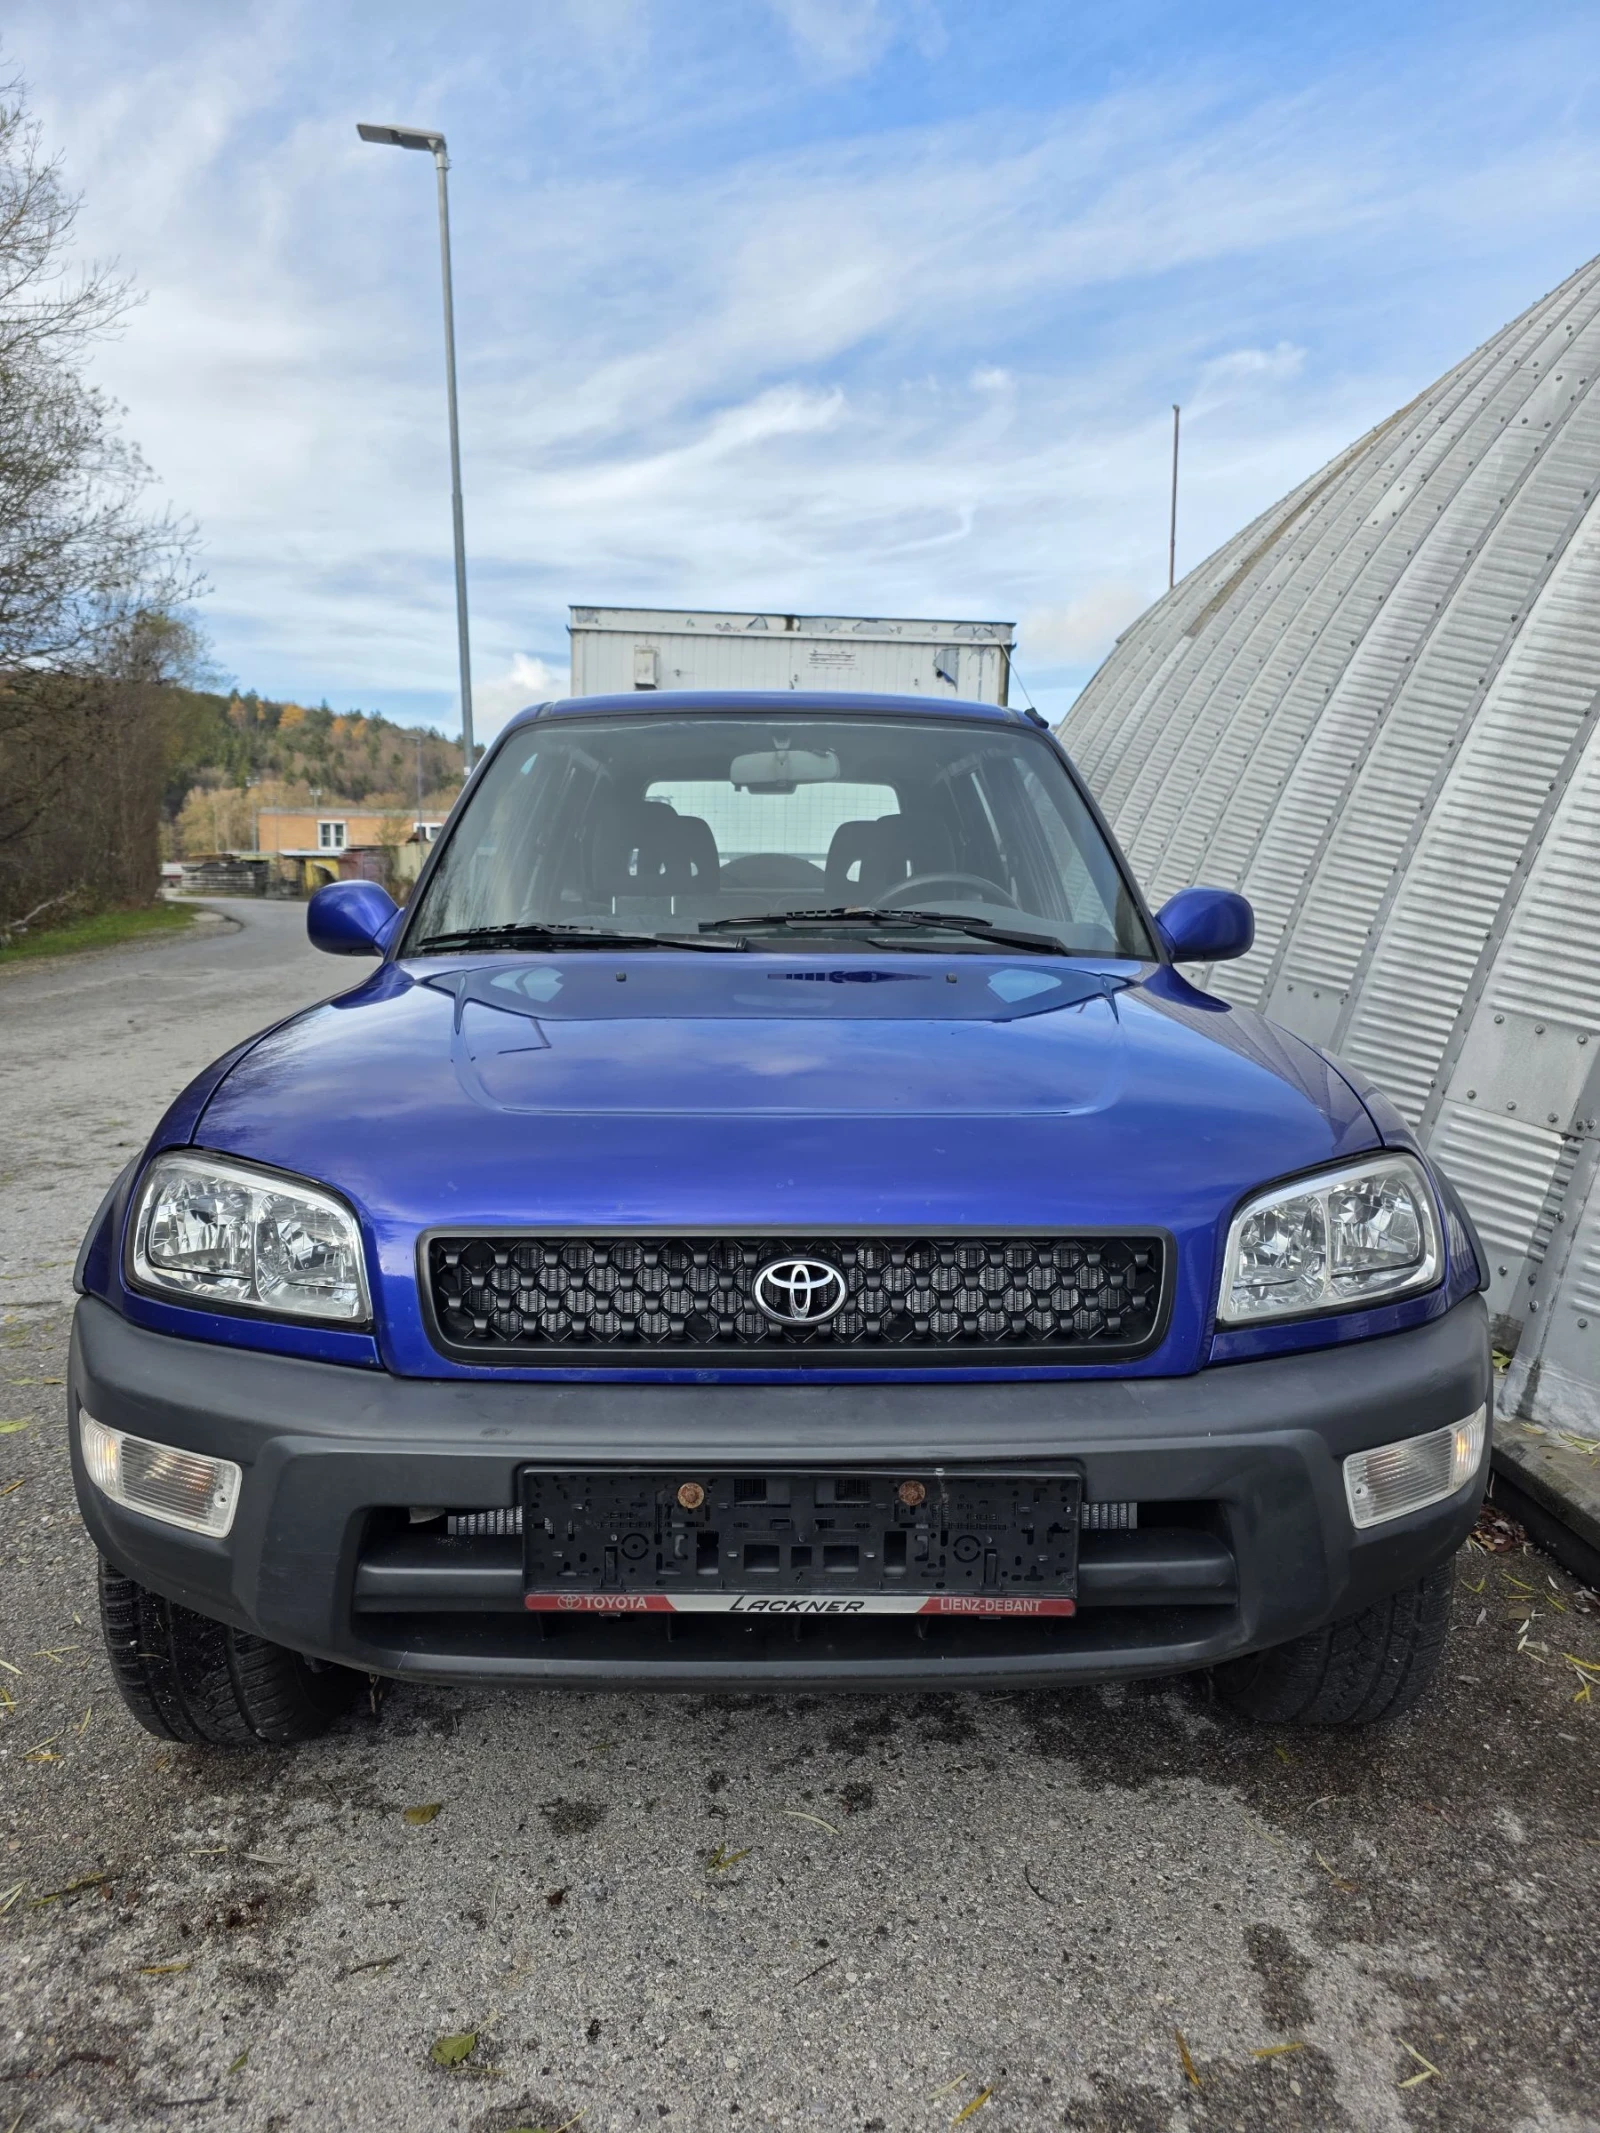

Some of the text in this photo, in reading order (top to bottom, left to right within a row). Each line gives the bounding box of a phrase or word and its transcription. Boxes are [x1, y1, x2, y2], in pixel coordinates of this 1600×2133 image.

[584, 1596, 1042, 1612] TOYOTA LACKNER LIENZ-DEBANT
